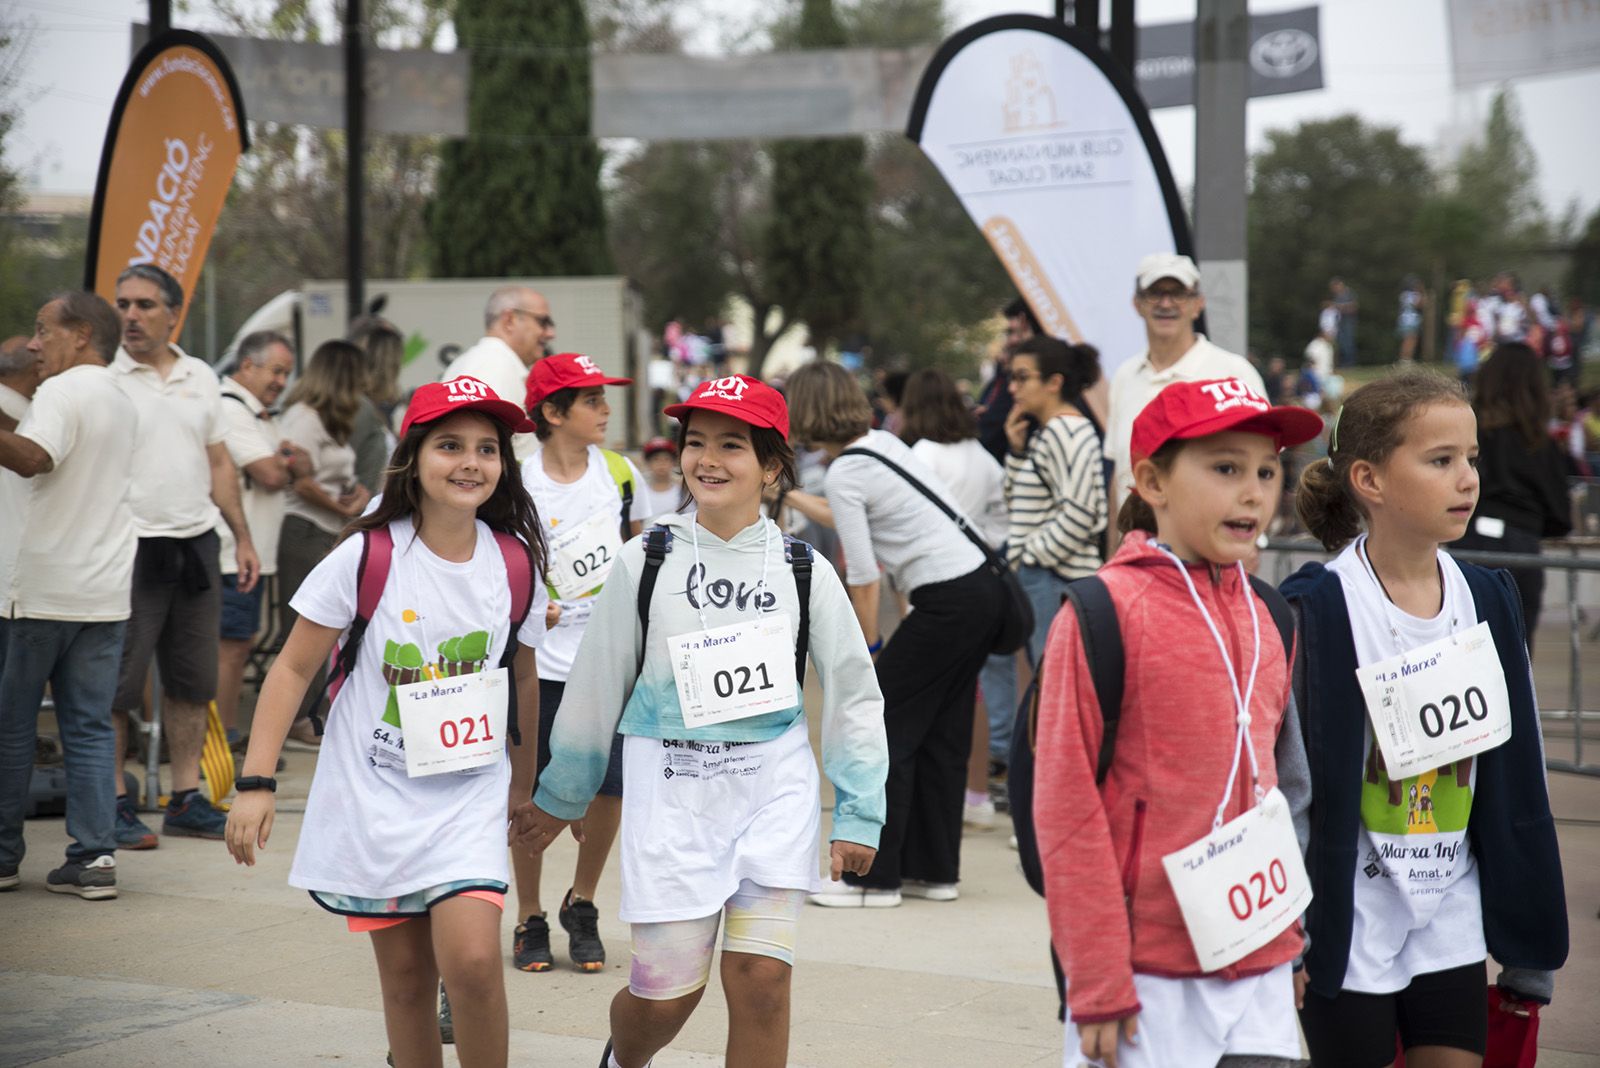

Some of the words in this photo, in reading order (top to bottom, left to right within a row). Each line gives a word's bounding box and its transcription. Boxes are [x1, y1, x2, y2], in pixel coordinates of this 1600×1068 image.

[128, 137, 189, 267] NDACIÓ
[443, 377, 488, 397] TOT
[708, 375, 749, 396] TOT
[572, 545, 611, 577] 022
[713, 662, 774, 698] 021
[1419, 686, 1488, 738] 020
[439, 714, 494, 748] 021
[1380, 843, 1431, 859] Marxa
[1227, 857, 1287, 921] 020
